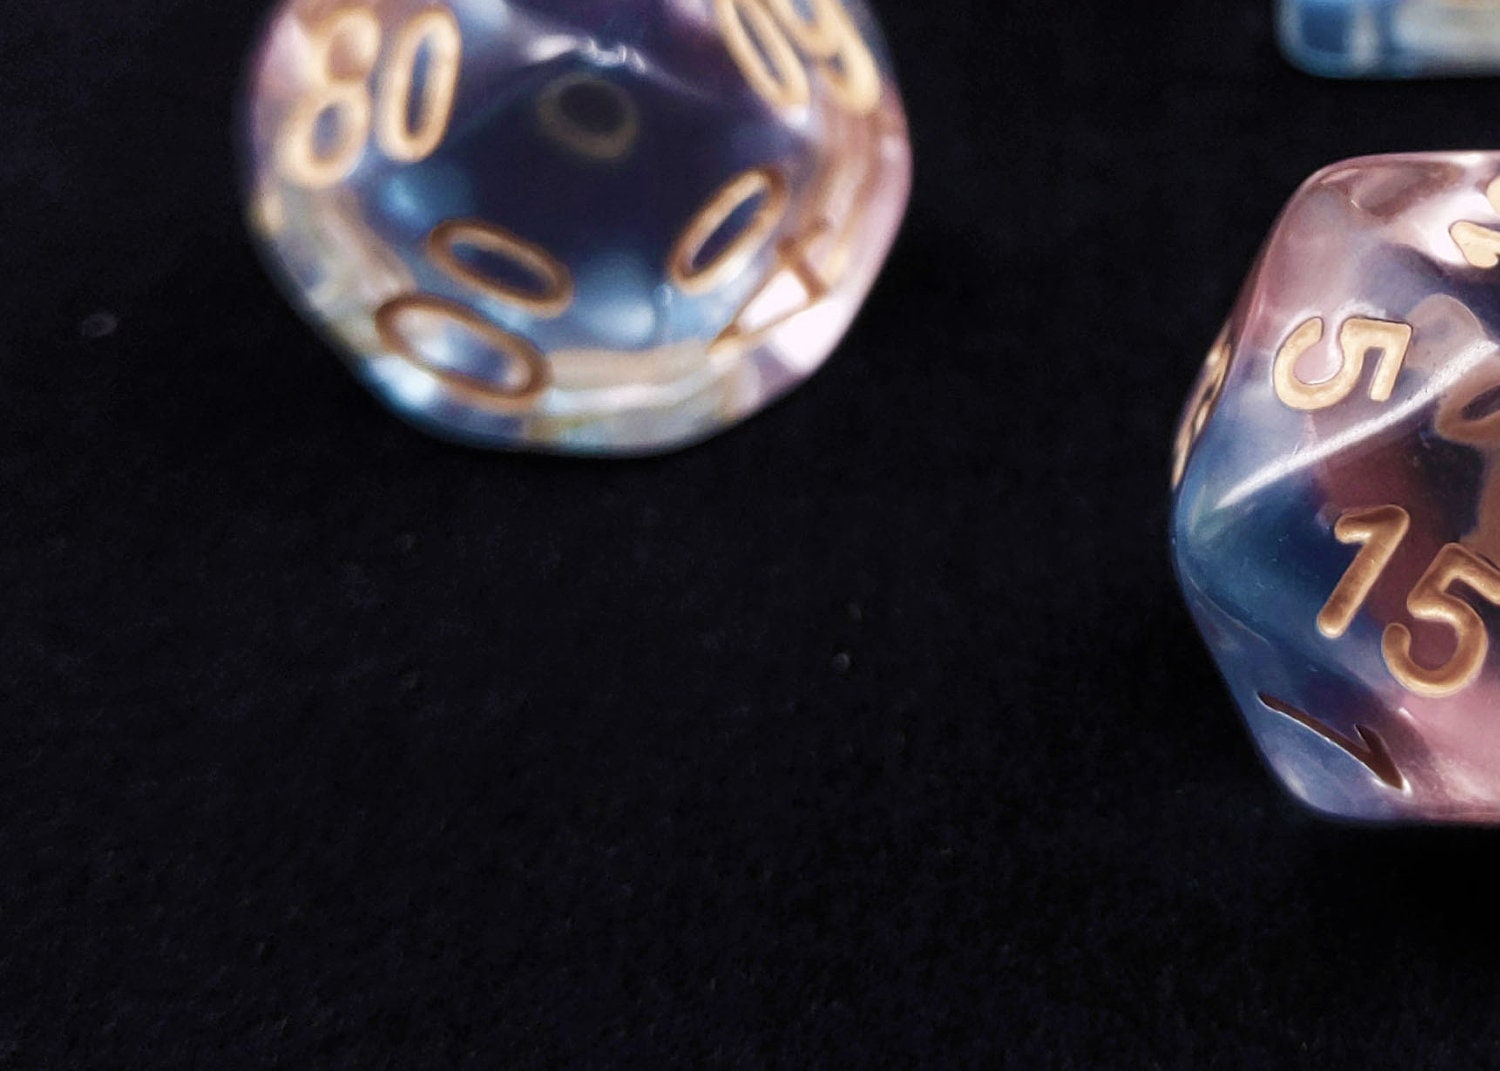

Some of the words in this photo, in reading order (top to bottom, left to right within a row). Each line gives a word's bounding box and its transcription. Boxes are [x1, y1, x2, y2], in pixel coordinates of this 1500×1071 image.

[283, 6, 462, 190] 80
[373, 221, 583, 410] 00
[1272, 315, 1413, 410] 5
